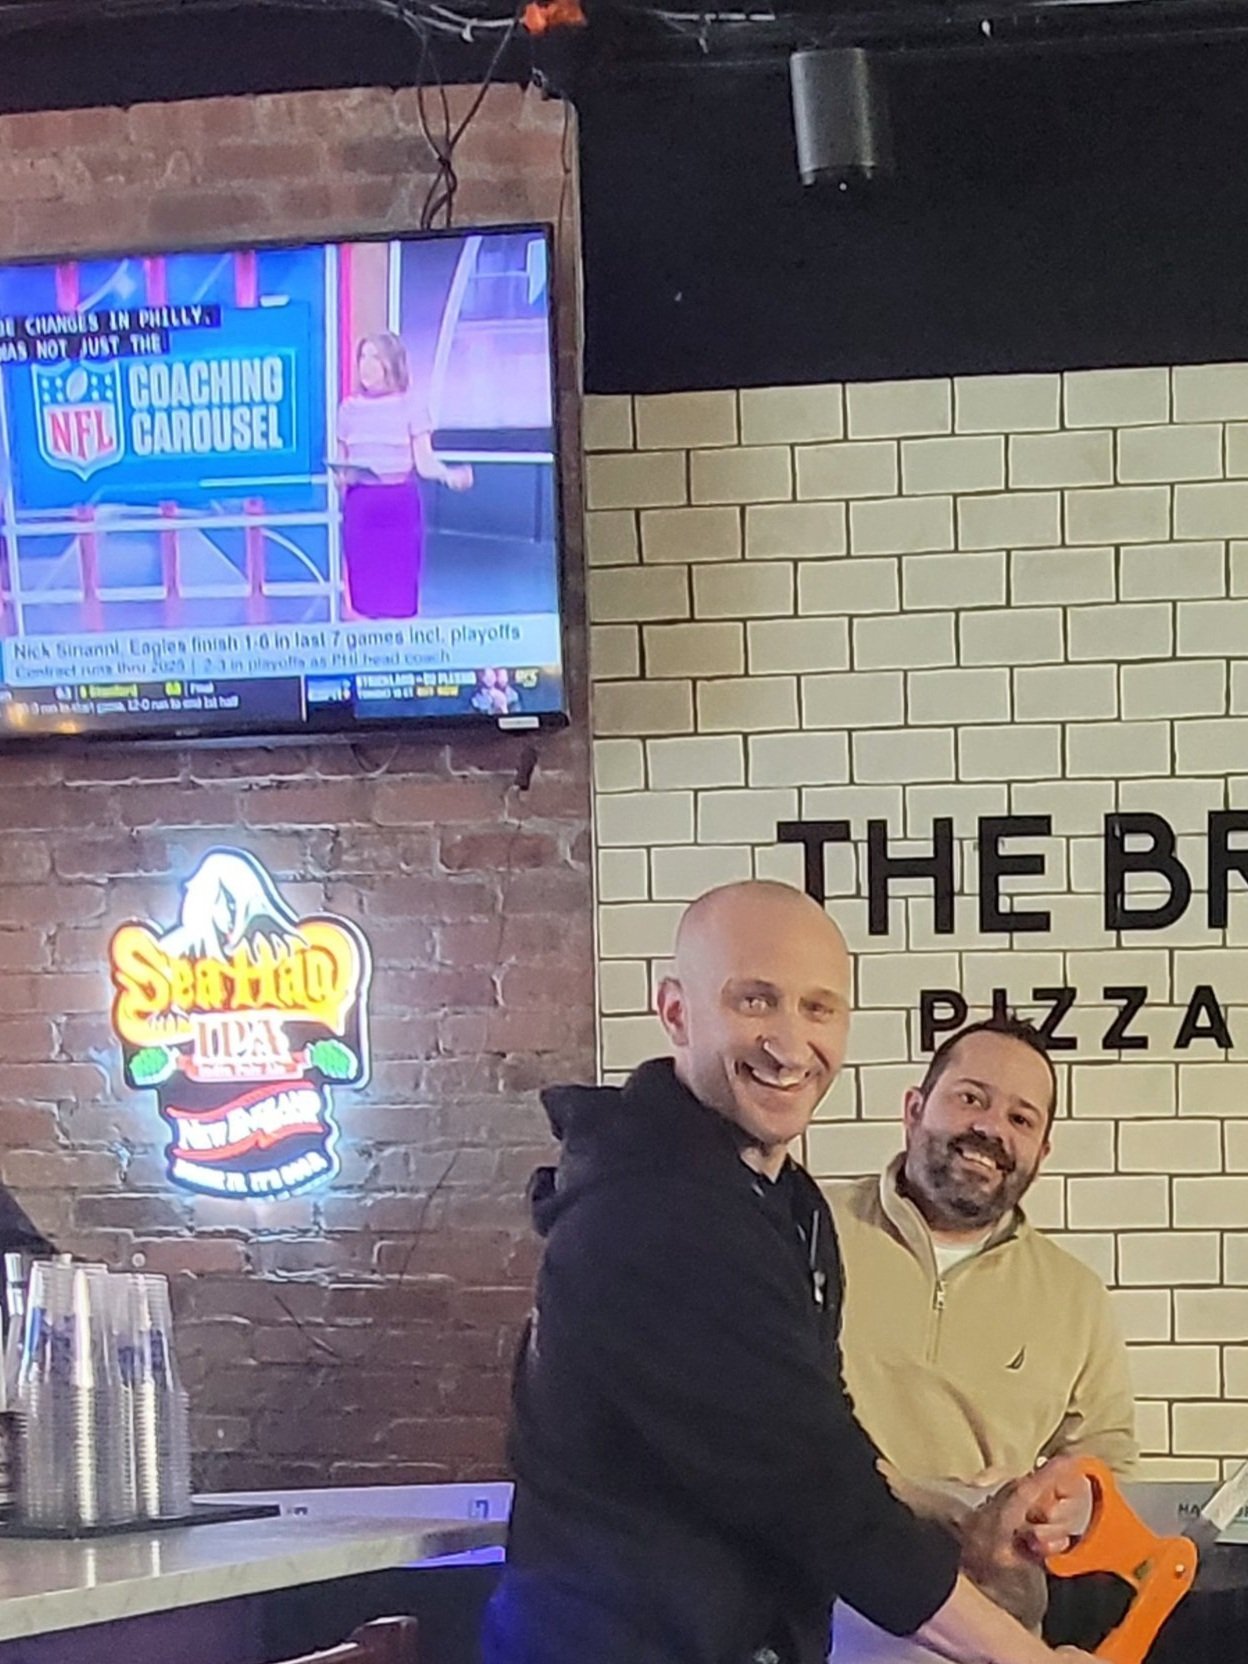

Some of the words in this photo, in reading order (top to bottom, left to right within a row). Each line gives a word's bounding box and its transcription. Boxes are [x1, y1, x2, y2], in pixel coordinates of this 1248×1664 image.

[36, 338, 69, 361] NOT
[80, 334, 120, 358] JUST
[130, 332, 161, 355] THE
[109, 310, 130, 331] IN
[128, 356, 284, 411] COACHING
[51, 409, 113, 461] NFL
[131, 404, 284, 456] CAROUSEL
[450, 623, 521, 647] playoffs
[777, 815, 1051, 935] THE
